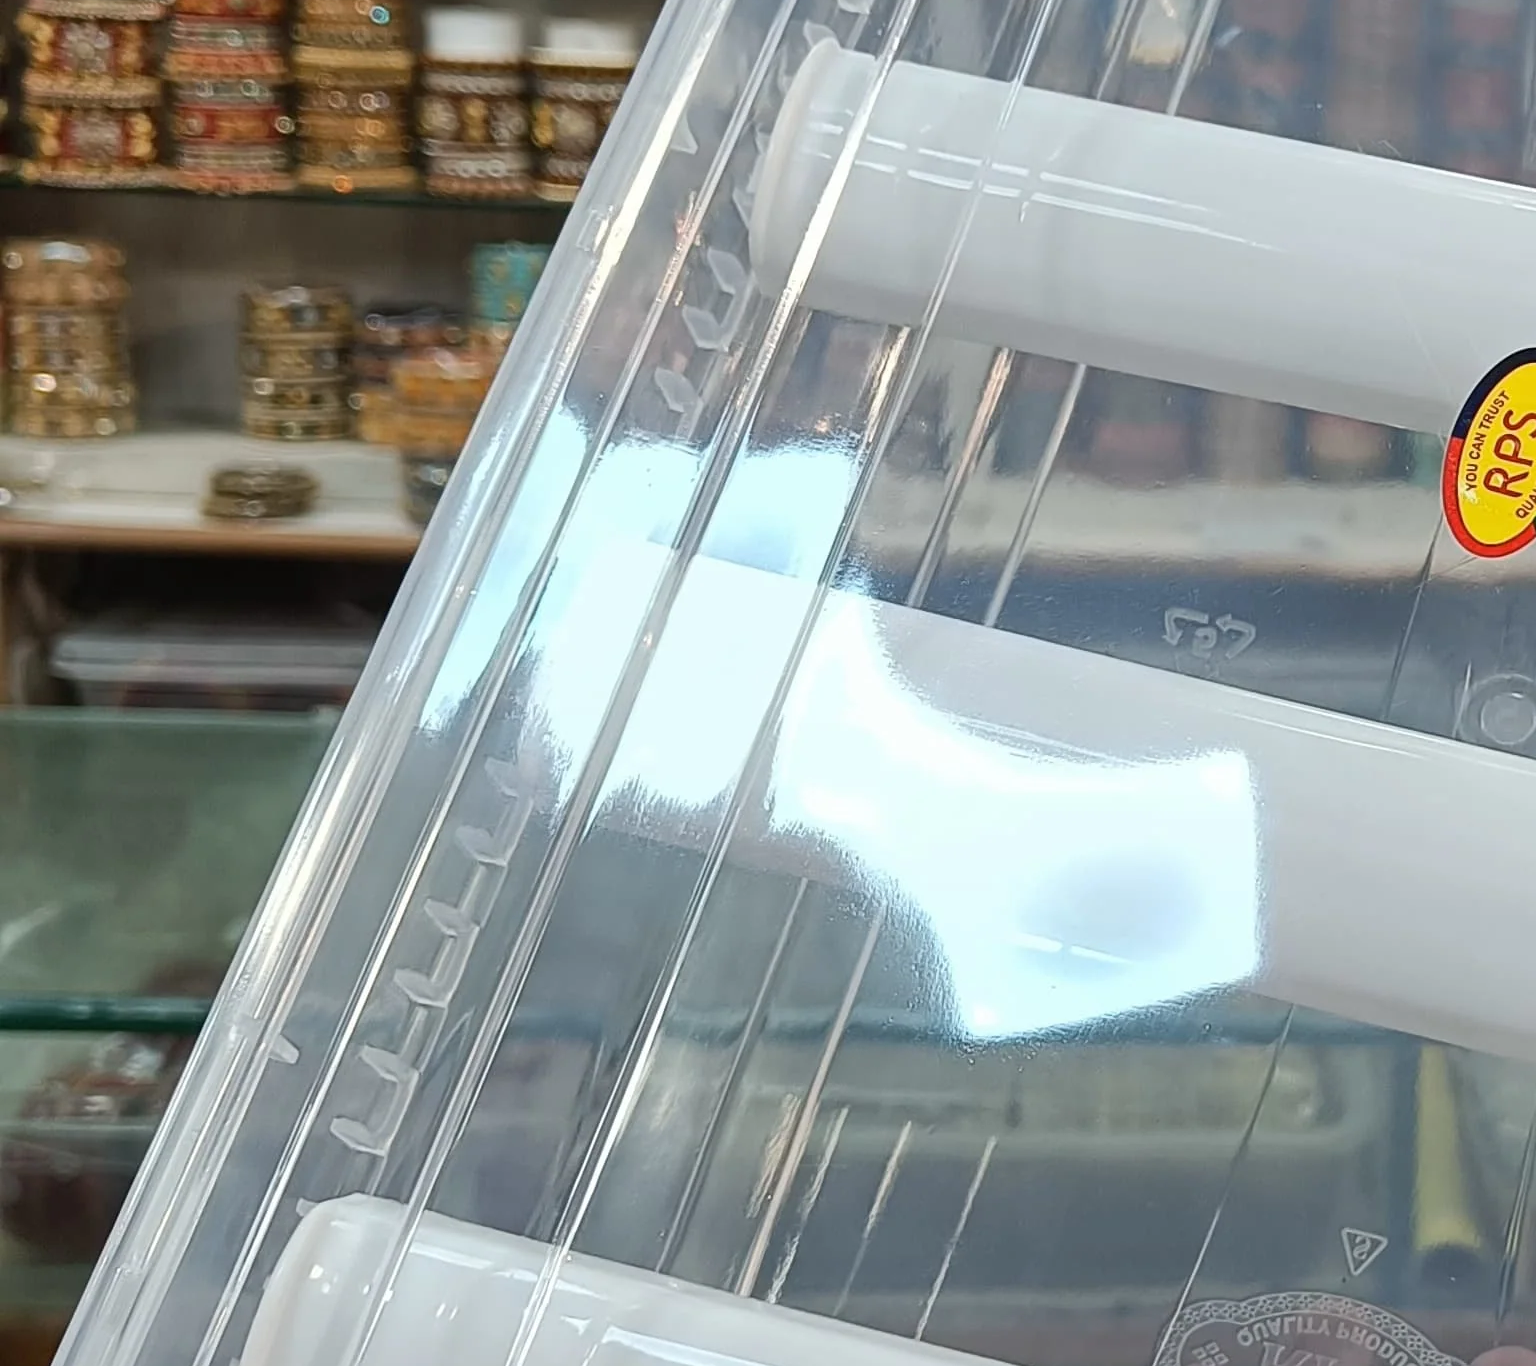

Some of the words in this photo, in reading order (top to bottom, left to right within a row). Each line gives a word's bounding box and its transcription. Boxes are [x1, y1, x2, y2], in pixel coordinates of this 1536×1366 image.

[1479, 389, 1511, 433] TRUST
[1469, 432, 1487, 460] CAN
[1465, 464, 1479, 492] YOU
